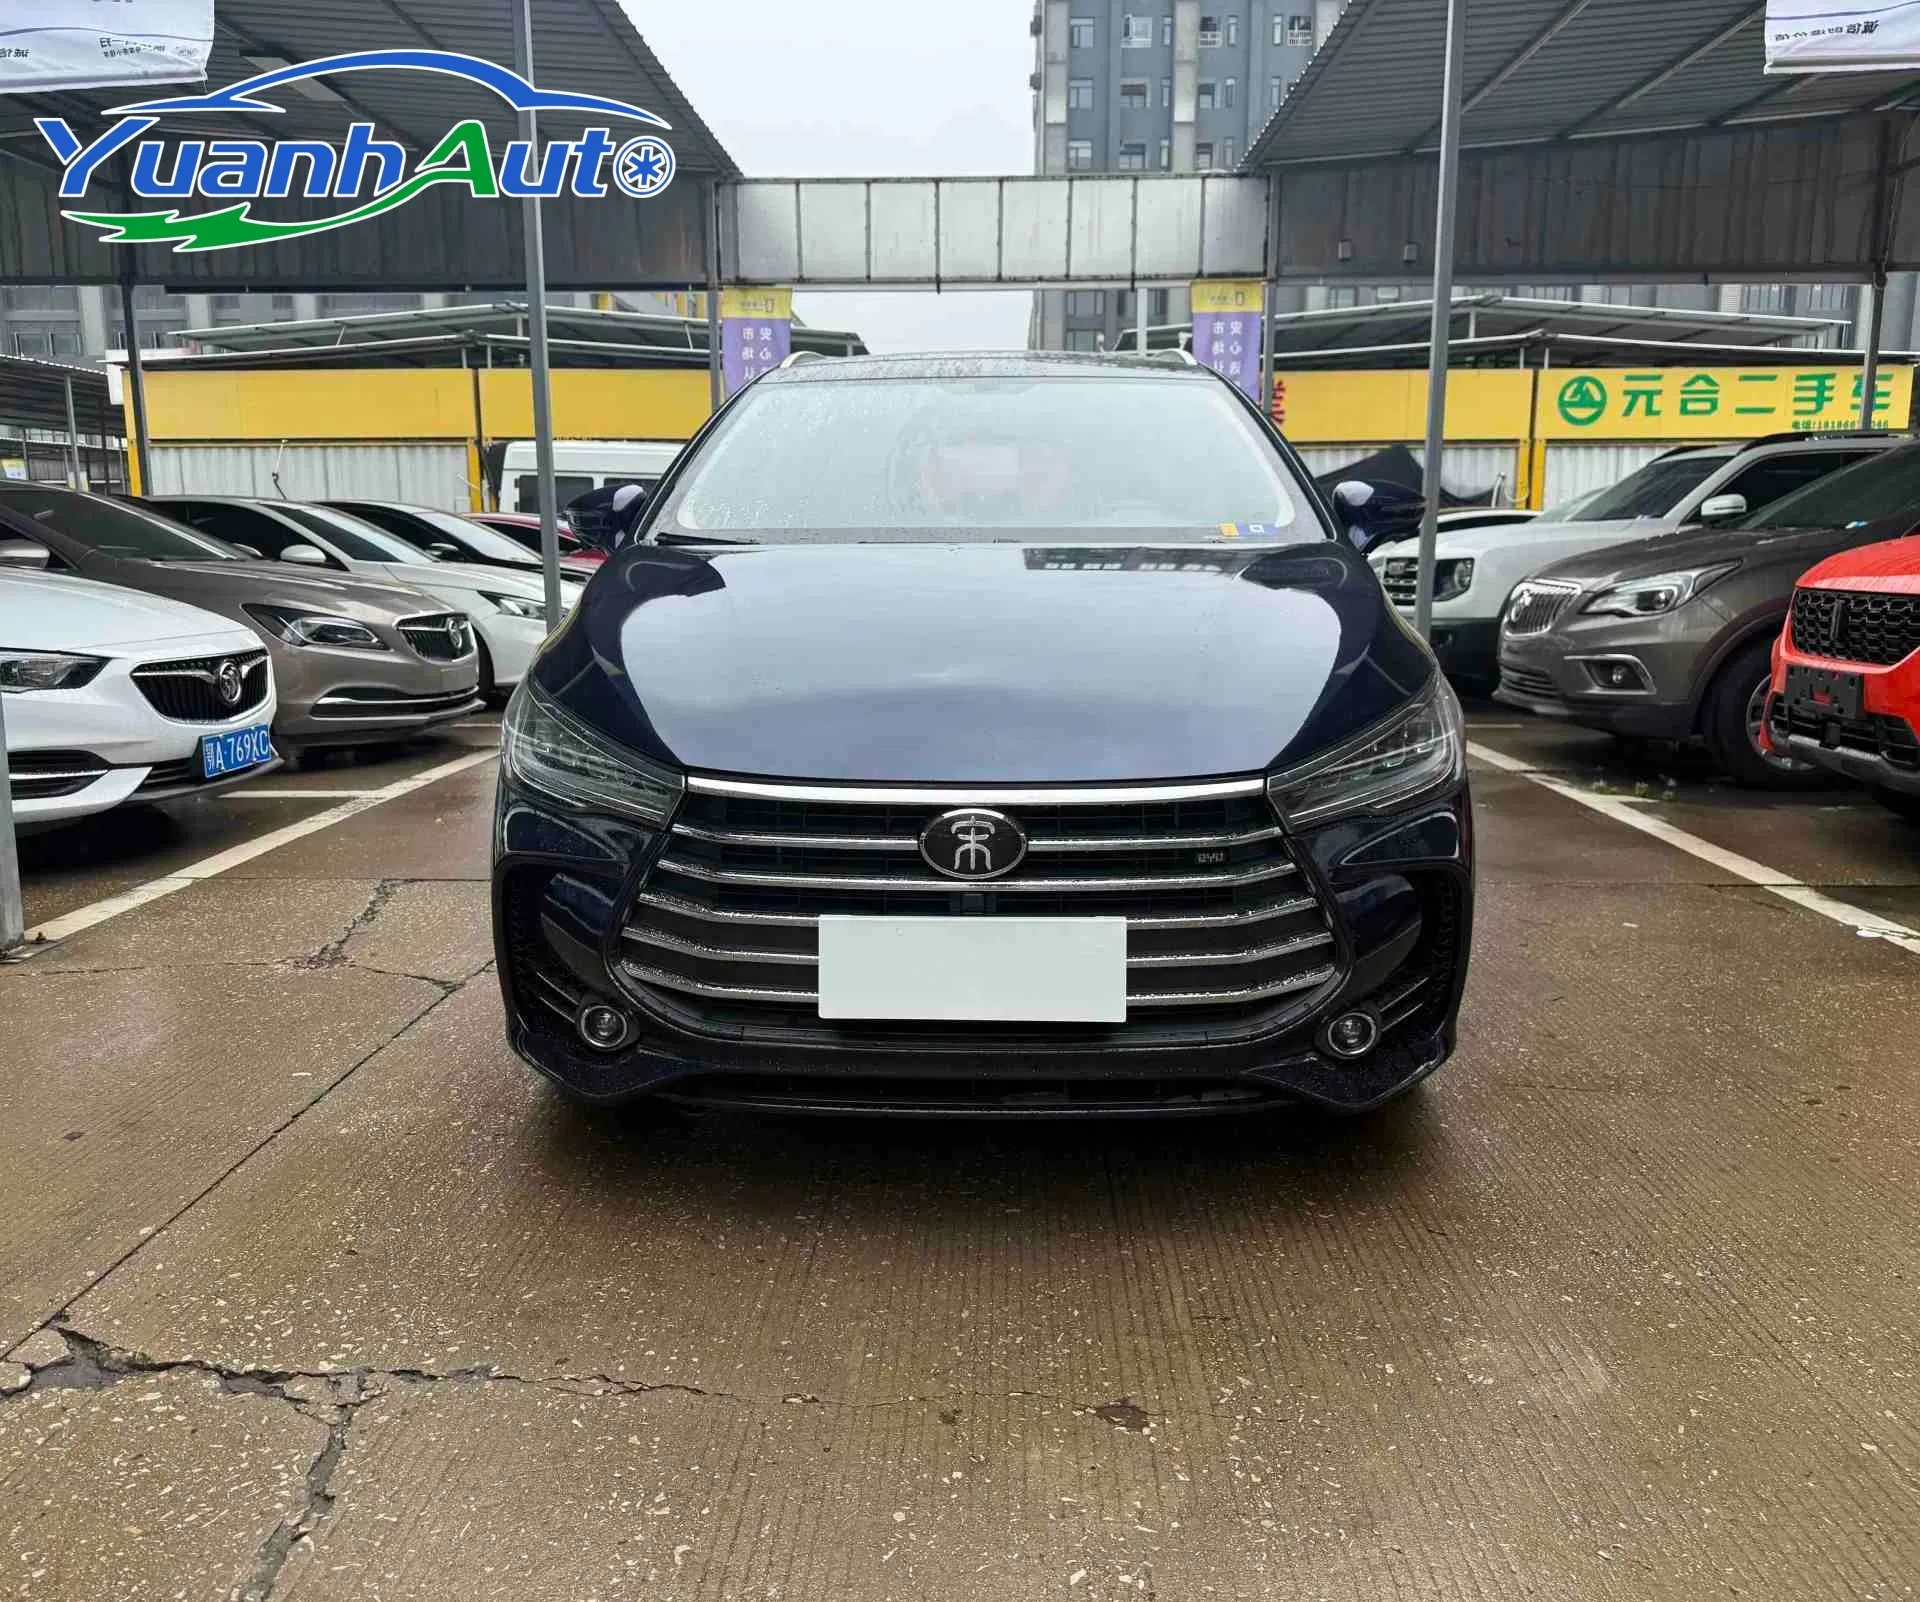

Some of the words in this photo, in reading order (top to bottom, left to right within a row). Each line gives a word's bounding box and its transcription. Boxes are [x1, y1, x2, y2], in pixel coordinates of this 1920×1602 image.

[1622, 372, 1894, 417] 元合二手车
